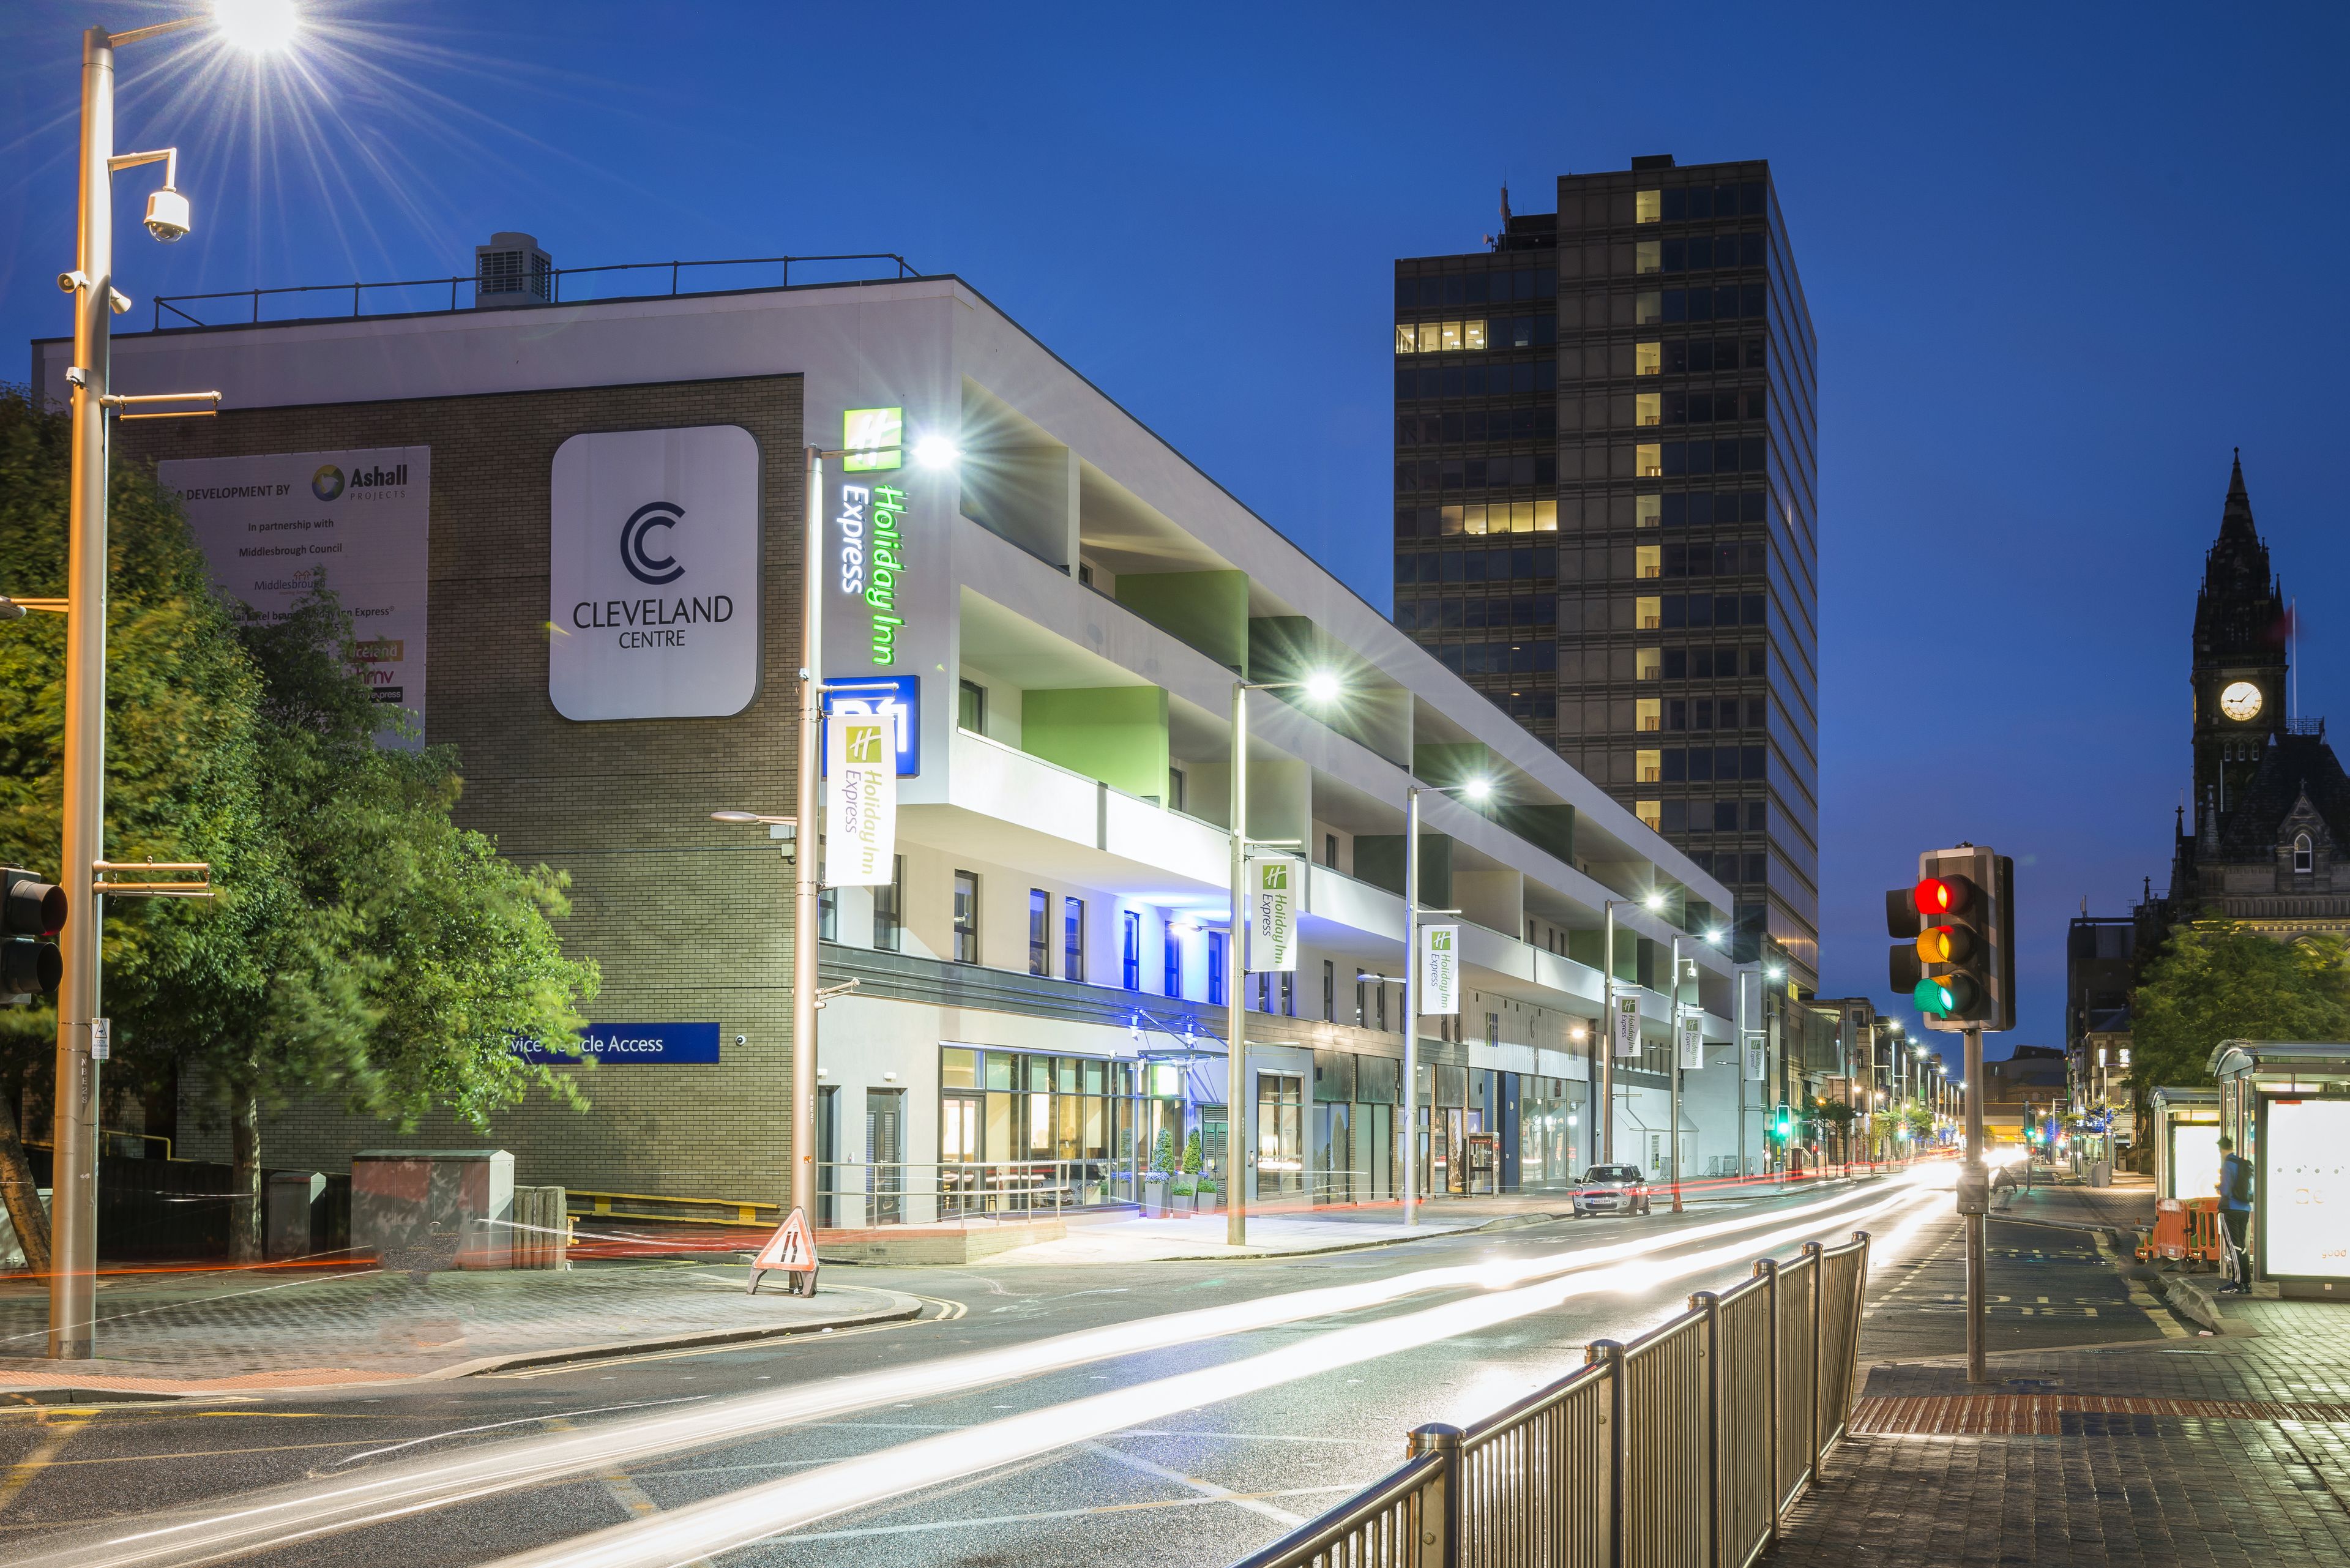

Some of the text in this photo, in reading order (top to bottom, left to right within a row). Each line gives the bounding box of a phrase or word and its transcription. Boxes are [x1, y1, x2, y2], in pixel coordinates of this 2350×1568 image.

[349, 464, 408, 488] Ashall
[186, 485, 273, 500] DEVELOPMENT
[275, 484, 290, 495] BY
[350, 490, 407, 501] PROJECTS
[248, 518, 334, 534] In partnership with
[836, 484, 870, 594] Express
[239, 543, 342, 558] Middlesbrough Council
[866, 484, 905, 666] Holiday Inn
[572, 595, 734, 629] CLEVELAND
[618, 630, 685, 649] CENTRE
[356, 665, 394, 684] hmv
[841, 769, 862, 834] Express
[858, 769, 882, 875] Holiday Inn
[1260, 894, 1273, 936] Express
[1272, 893, 1287, 964] Holiday Inn
[1429, 953, 1440, 987] Express
[1439, 953, 1451, 1009] Holiday Inn
[1627, 1015, 1635, 1042] Holiday
[608, 1035, 663, 1053] Access
